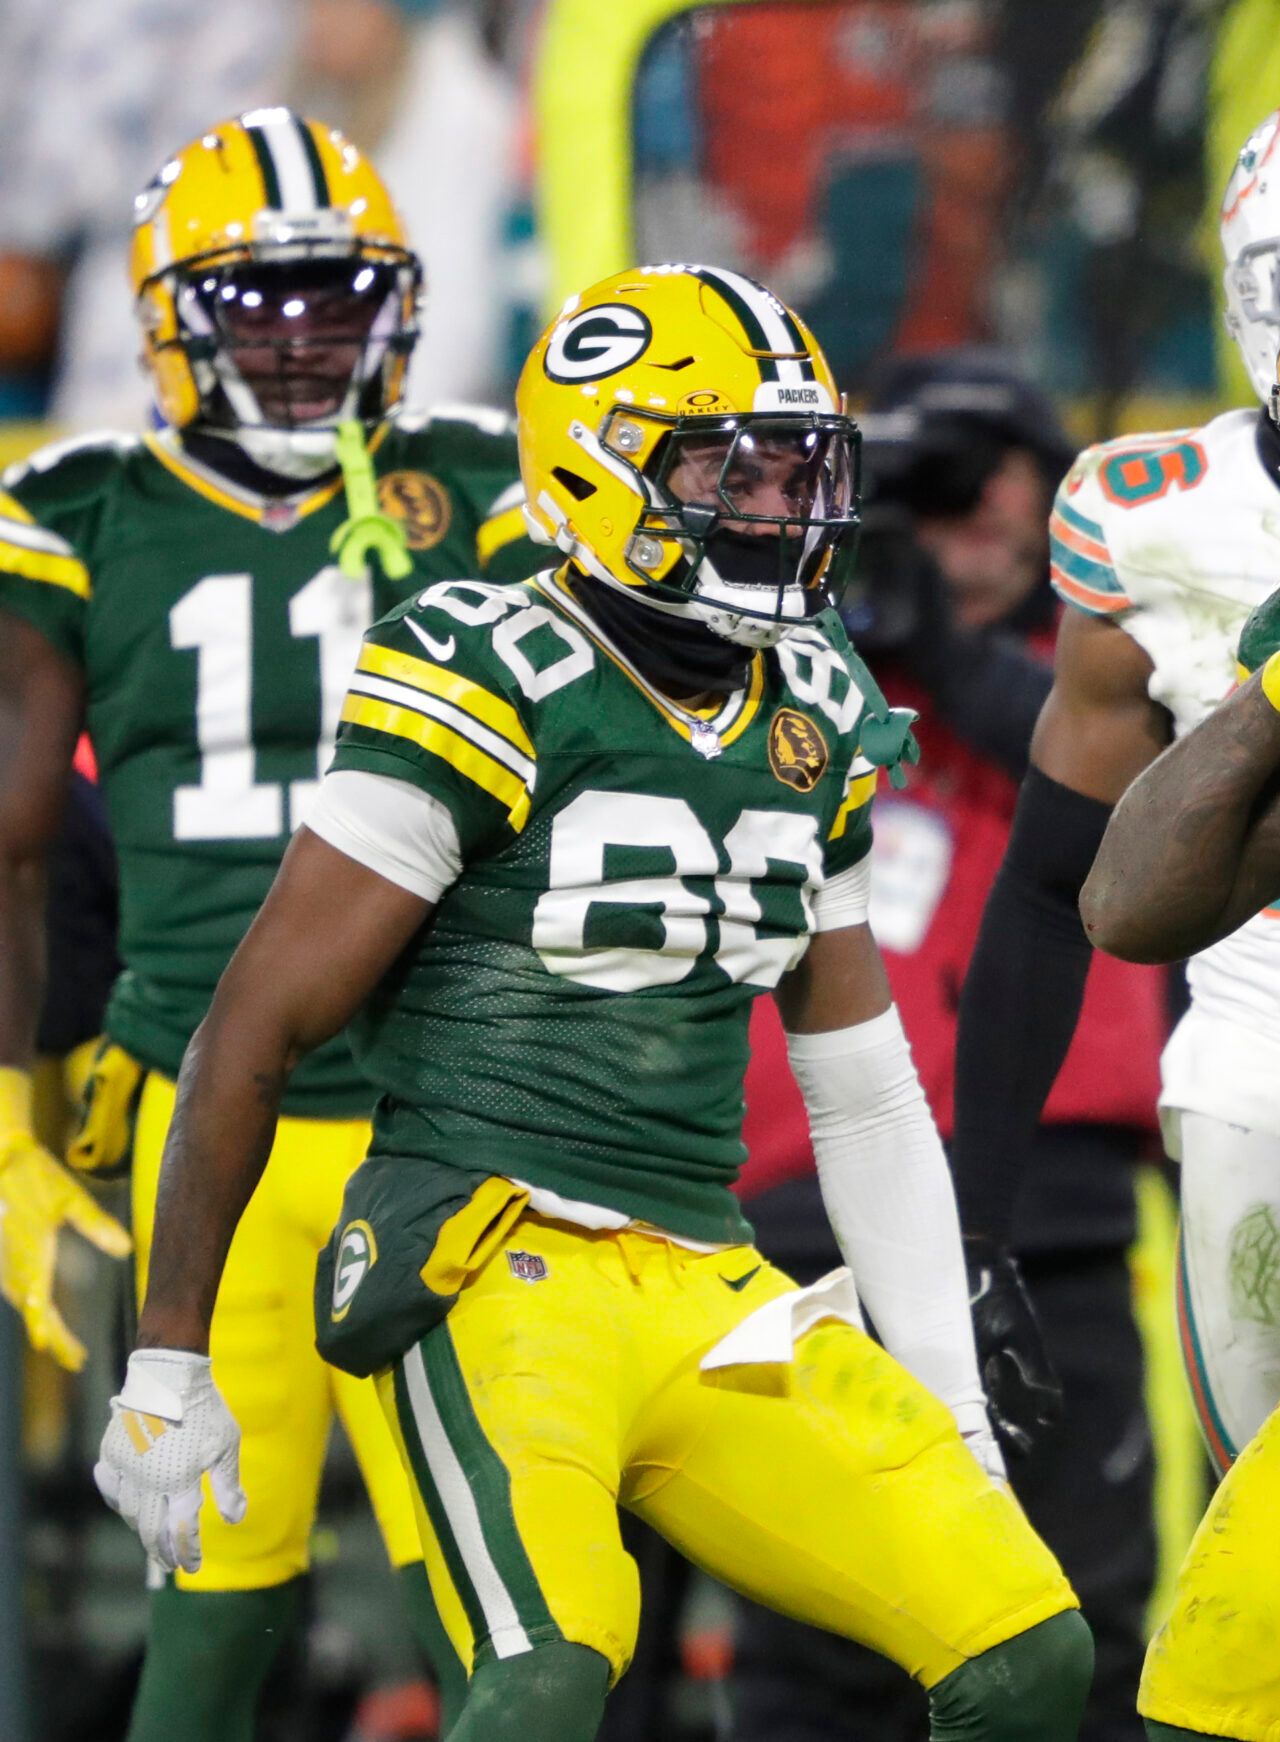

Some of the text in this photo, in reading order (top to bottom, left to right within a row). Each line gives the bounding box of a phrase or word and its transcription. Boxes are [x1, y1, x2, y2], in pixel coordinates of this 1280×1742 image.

[543, 303, 652, 384] G
[680, 405, 729, 417] OAKLEY
[777, 388, 820, 404] PACKERS
[168, 564, 375, 841] 11
[531, 790, 824, 993] 80
